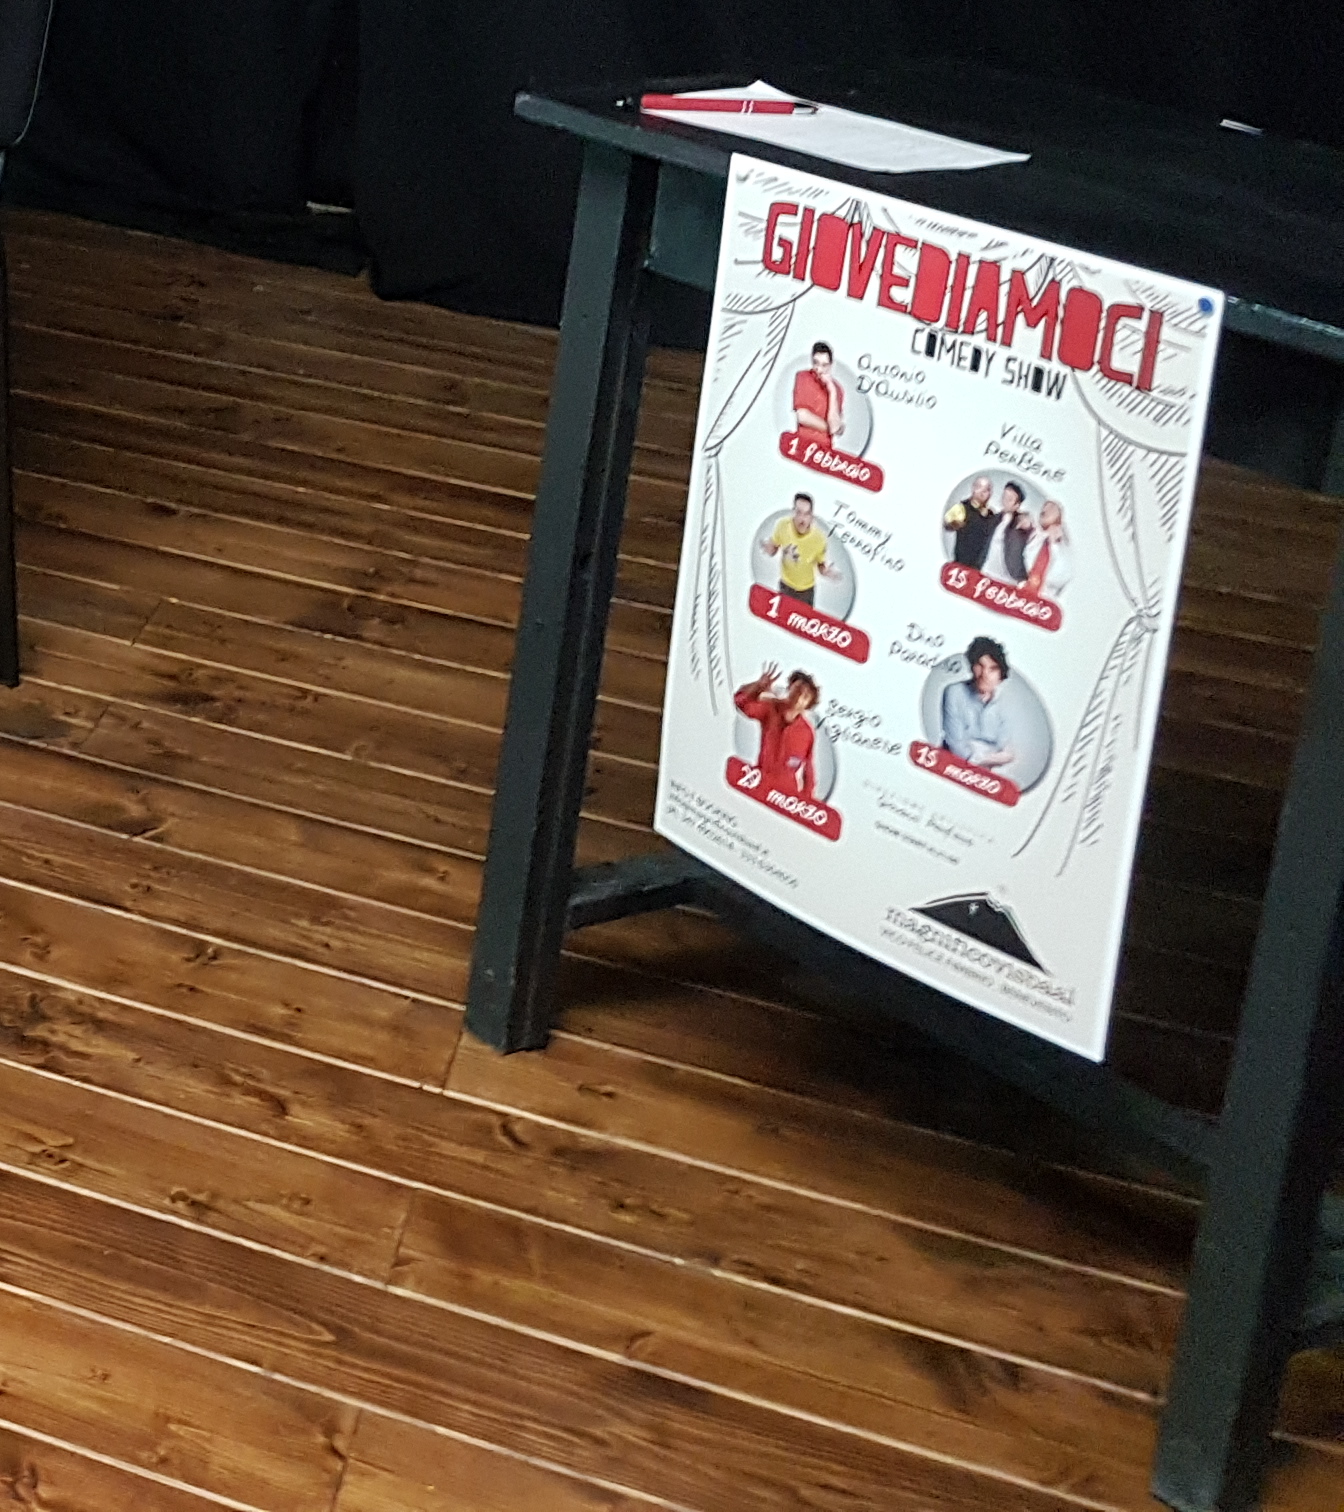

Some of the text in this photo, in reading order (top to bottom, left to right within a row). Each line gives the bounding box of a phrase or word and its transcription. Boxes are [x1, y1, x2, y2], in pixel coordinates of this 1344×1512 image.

[761, 200, 1164, 393] GIOVEDIAMOCI
[911, 327, 1069, 402] COMEDY SHOW
[787, 438, 800, 456] 1
[999, 421, 1044, 454] Villa
[946, 567, 969, 589] 15
[765, 595, 781, 619] 1
[916, 746, 939, 768] 15
